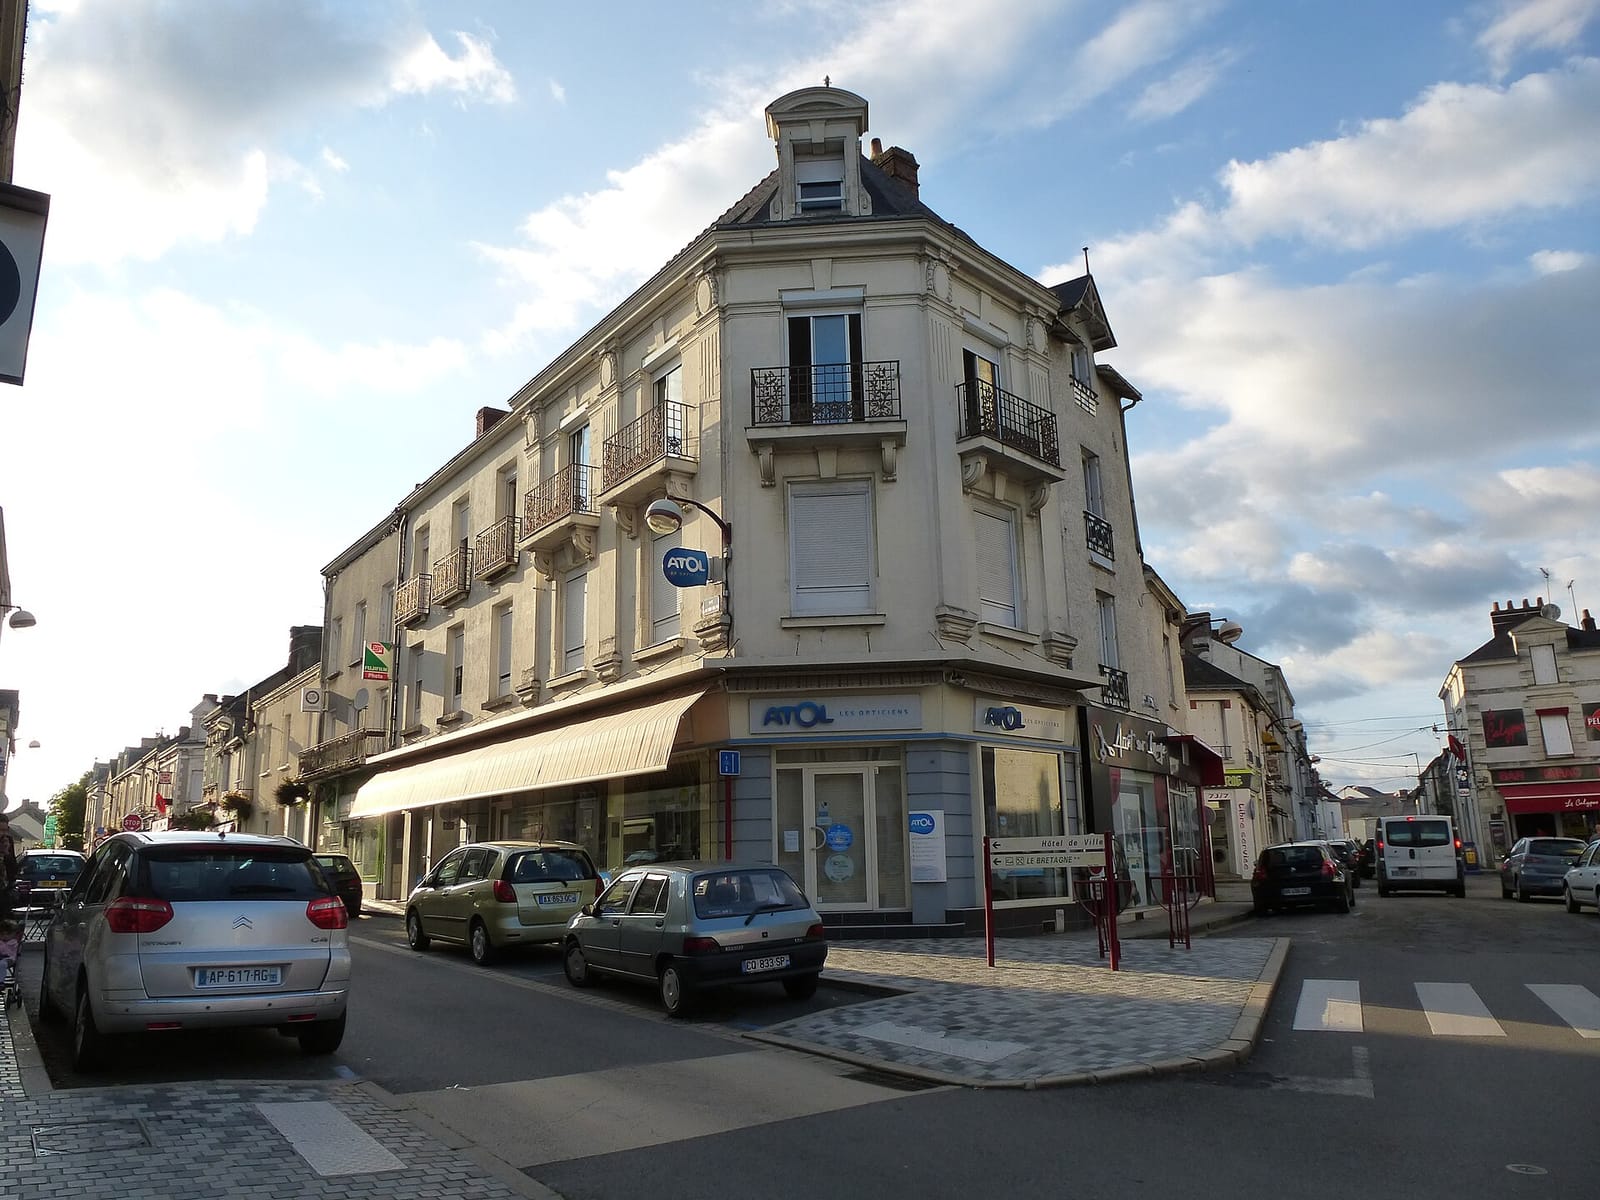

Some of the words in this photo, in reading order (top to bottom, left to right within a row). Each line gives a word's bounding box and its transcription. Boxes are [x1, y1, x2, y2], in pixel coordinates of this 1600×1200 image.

[668, 556, 706, 572] ATOL
[763, 701, 835, 728] ATOL
[859, 709, 909, 717] OPTICIENS
[984, 706, 1026, 730] ATOL
[911, 818, 933, 827] ATOL
[1238, 803, 1246, 828] Libre
[1041, 839, 1063, 847] Hôtel
[1068, 839, 1078, 847] de
[1026, 857, 1034, 865] LE
